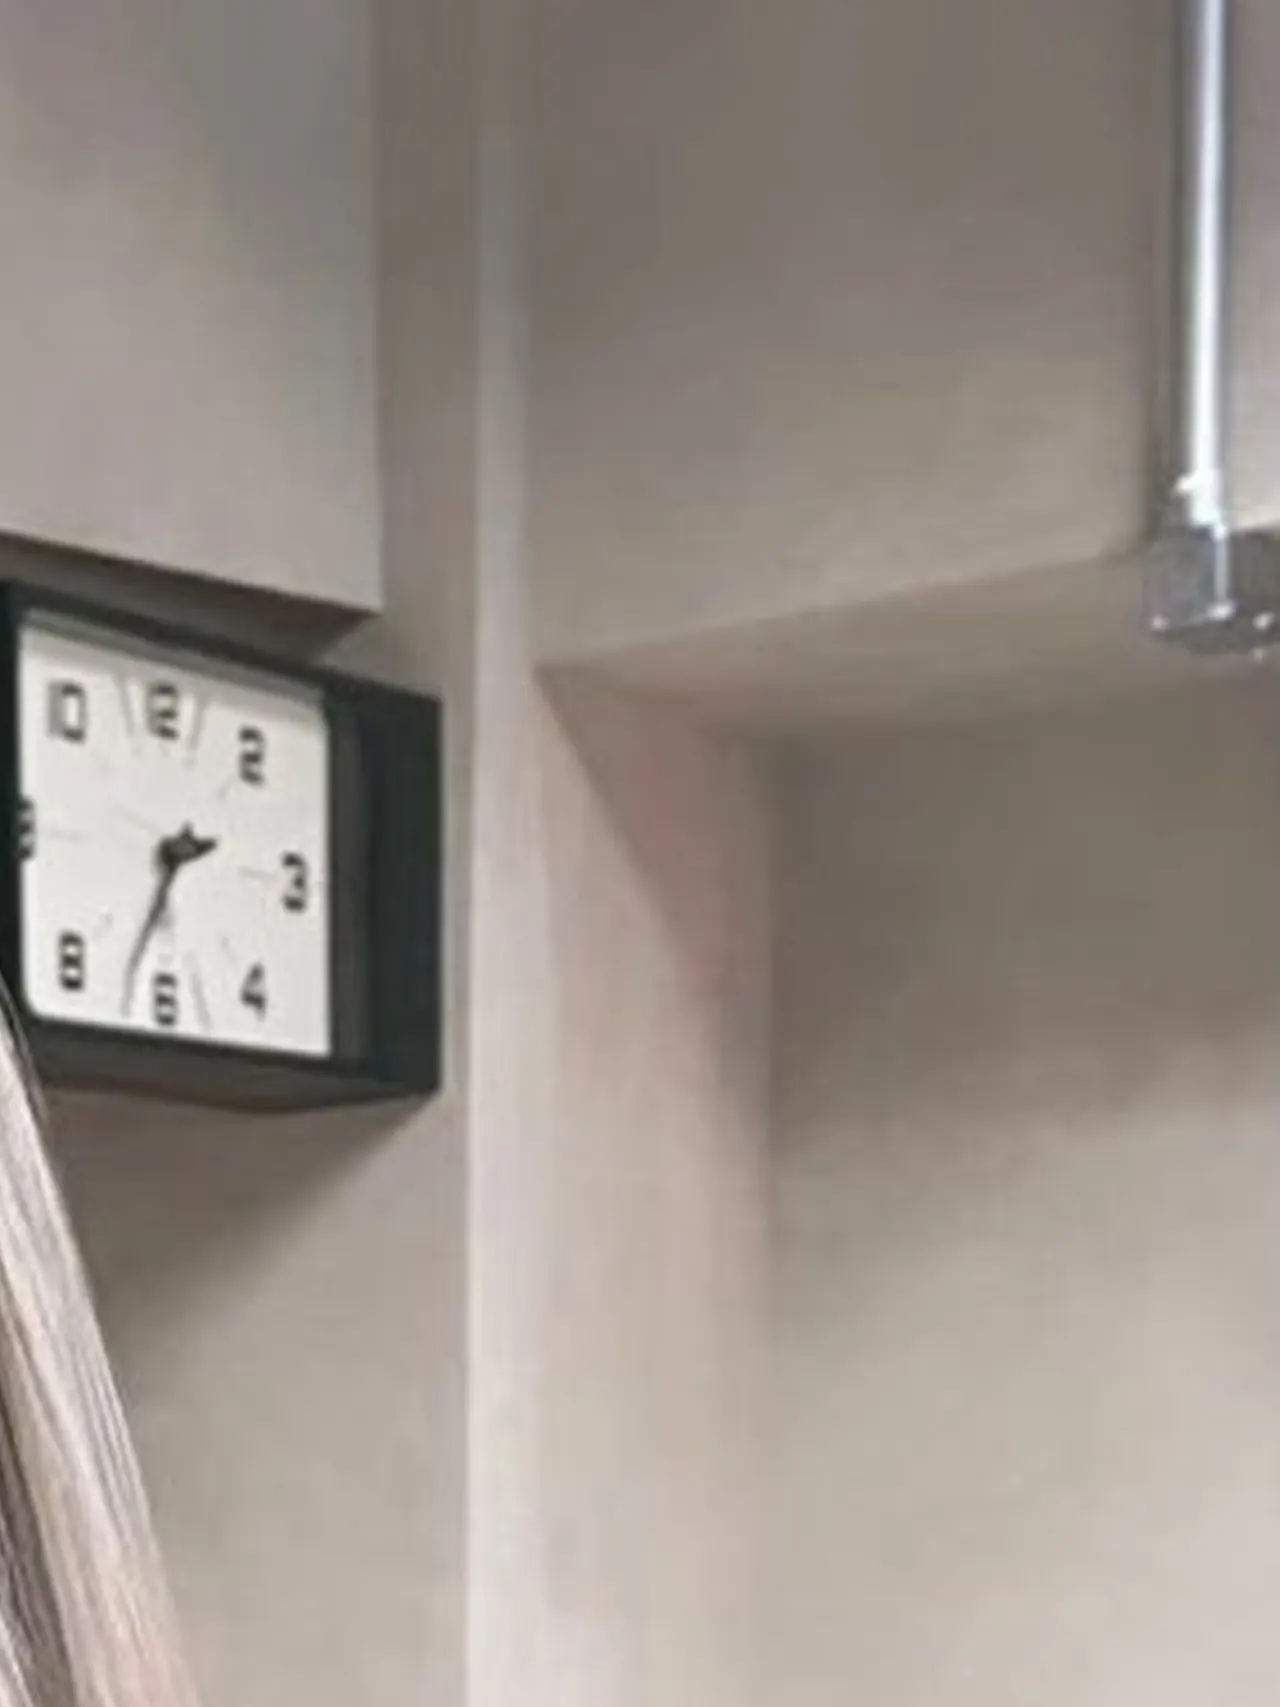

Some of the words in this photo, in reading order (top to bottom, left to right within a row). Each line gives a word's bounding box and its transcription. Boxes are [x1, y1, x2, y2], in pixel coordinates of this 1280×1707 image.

[239, 726, 266, 786] 2
[282, 851, 308, 913] 3
[58, 929, 85, 992] 8
[241, 962, 267, 1021] 4
